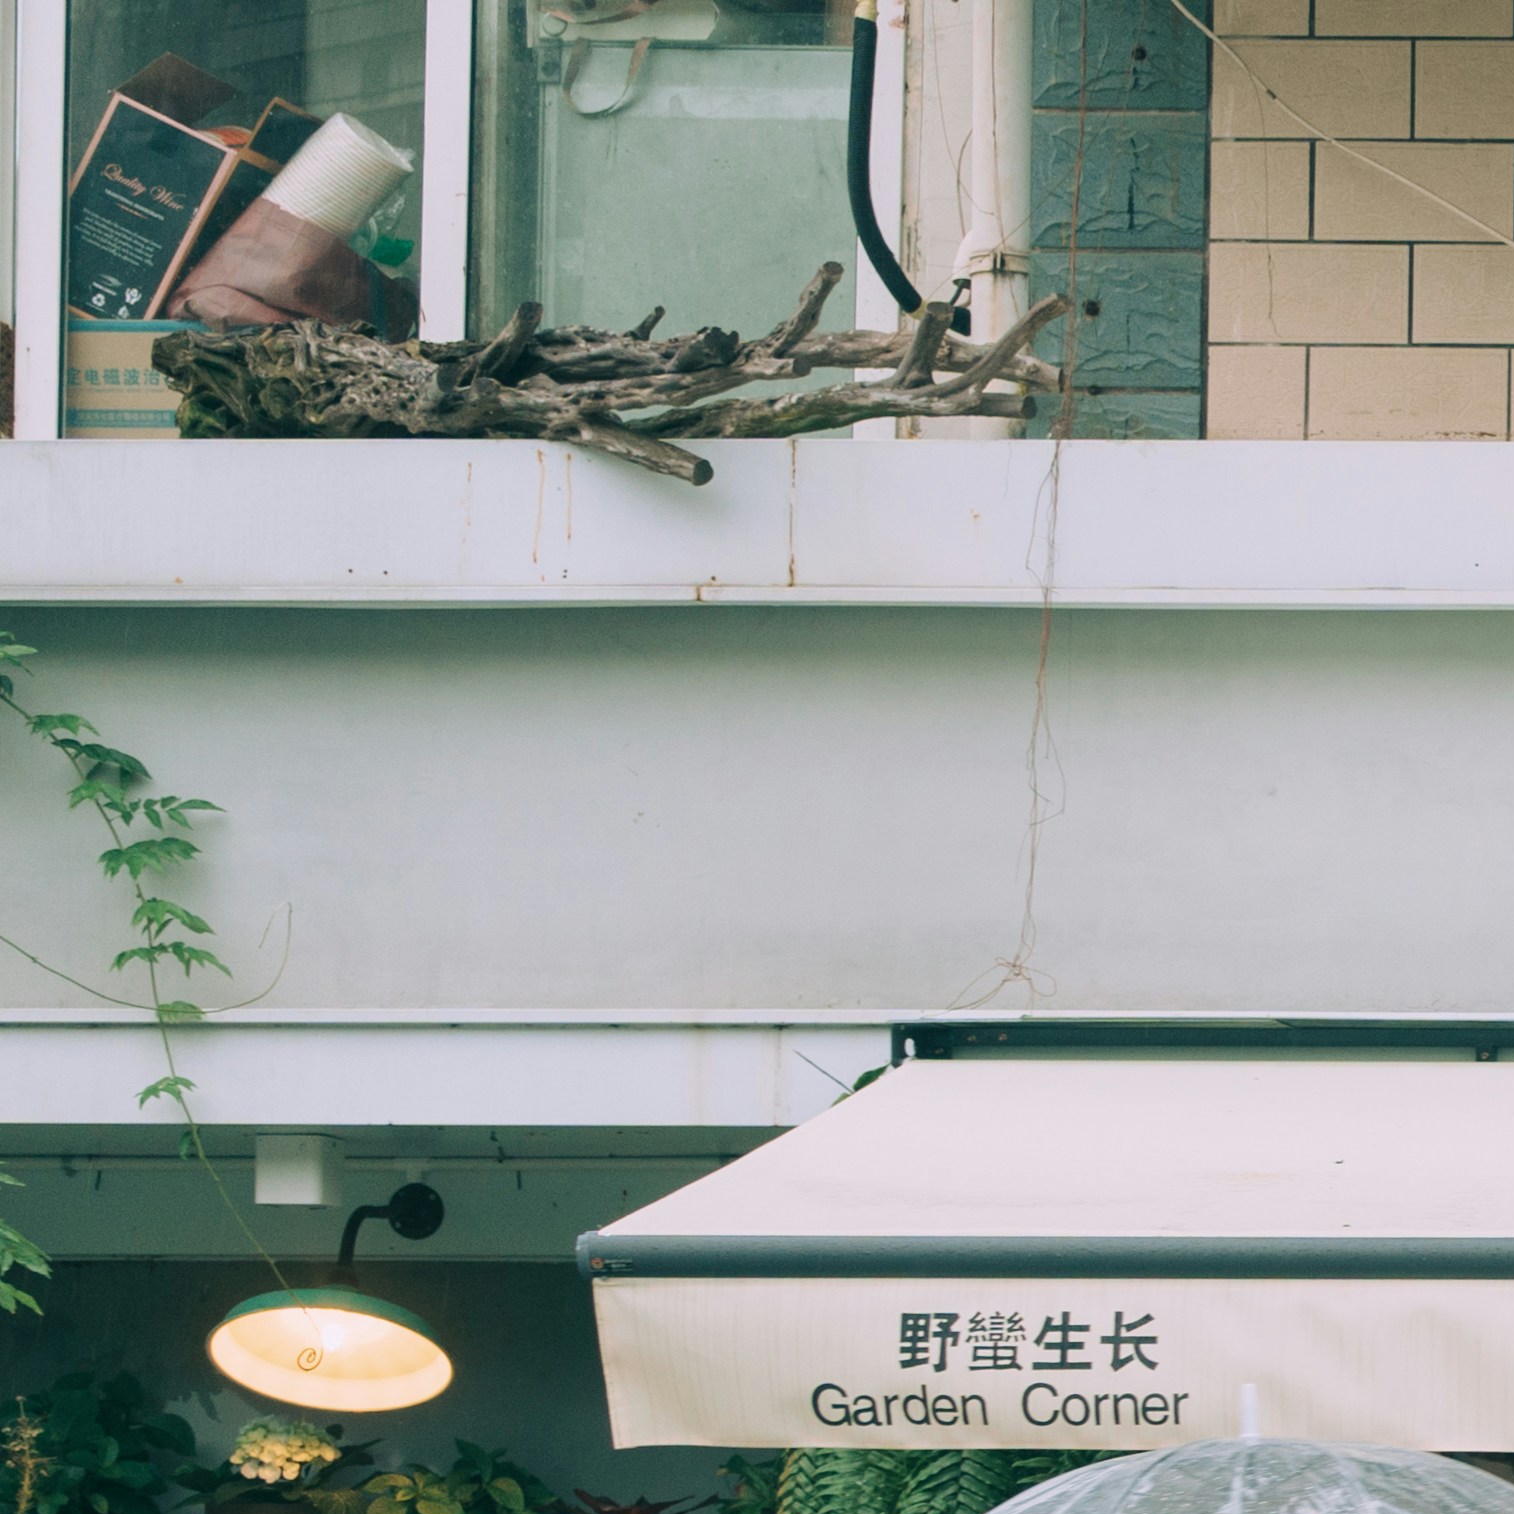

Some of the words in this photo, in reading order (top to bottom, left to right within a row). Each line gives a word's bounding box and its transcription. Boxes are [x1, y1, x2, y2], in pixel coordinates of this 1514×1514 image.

[103, 163, 146, 197] Quality
[150, 185, 187, 211] Wine
[899, 1311, 1158, 1373] 野蠻生长
[811, 1382, 989, 1427] Garden
[1021, 1382, 1189, 1427] Corner
